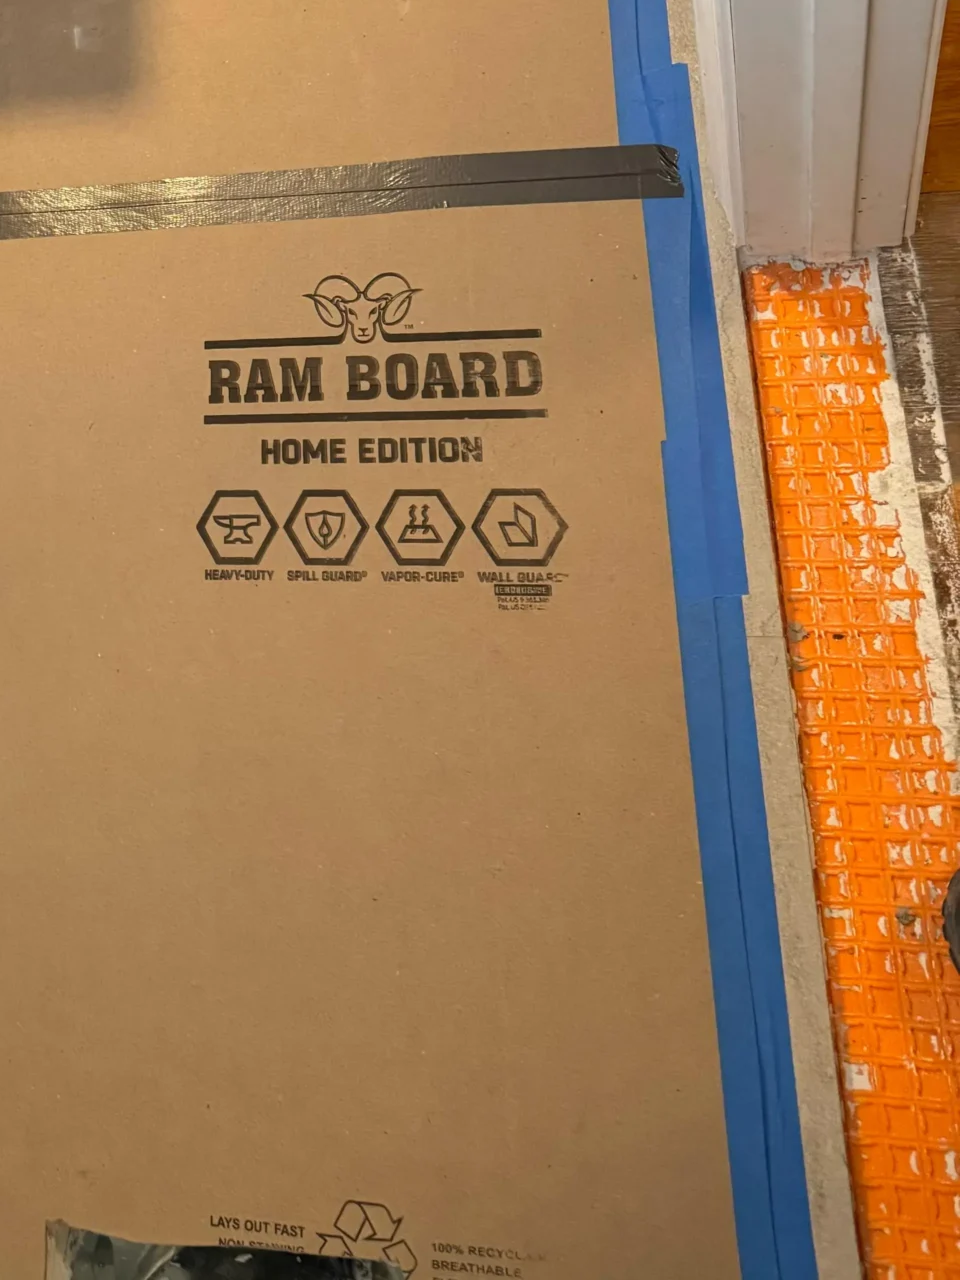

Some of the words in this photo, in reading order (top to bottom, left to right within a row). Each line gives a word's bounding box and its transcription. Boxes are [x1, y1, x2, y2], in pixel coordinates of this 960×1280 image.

[208, 356, 324, 404] RAM
[345, 350, 544, 401] BOARD
[261, 438, 347, 464] HOME
[358, 436, 484, 464] EDITION
[204, 569, 274, 581] HEAVY-DUTY
[287, 570, 319, 582] SPILL
[476, 572, 514, 583] WALL
[210, 1215, 240, 1230] LAYS
[244, 1220, 270, 1234] OUT
[274, 1223, 305, 1238] FAST
[432, 1242, 464, 1255] 100%
[432, 1259, 523, 1278] BREATHABLE
